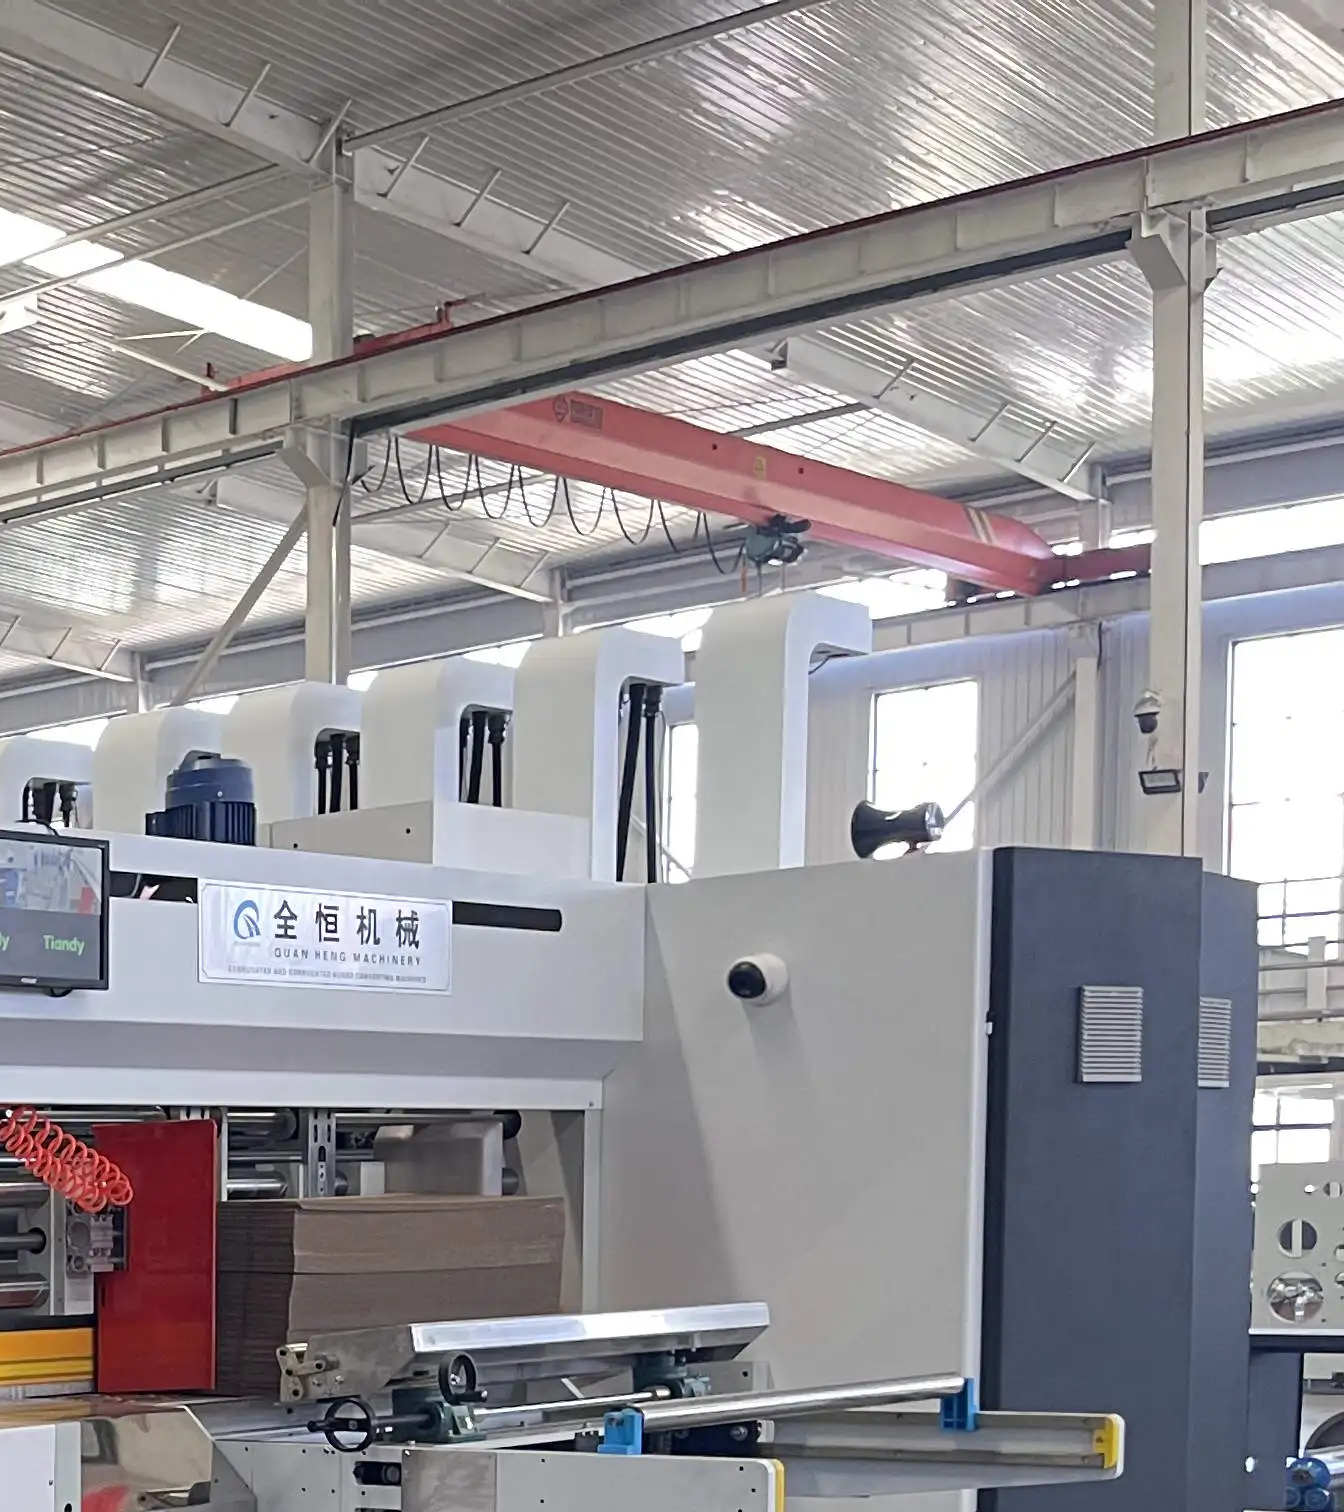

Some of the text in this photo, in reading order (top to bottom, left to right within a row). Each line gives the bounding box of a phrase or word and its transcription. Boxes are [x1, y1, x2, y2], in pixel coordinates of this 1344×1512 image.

[273, 899, 421, 949] 全恒机械
[43, 934, 85, 956] Tiandy
[274, 947, 421, 966] QUAN HENG MACHINERY
